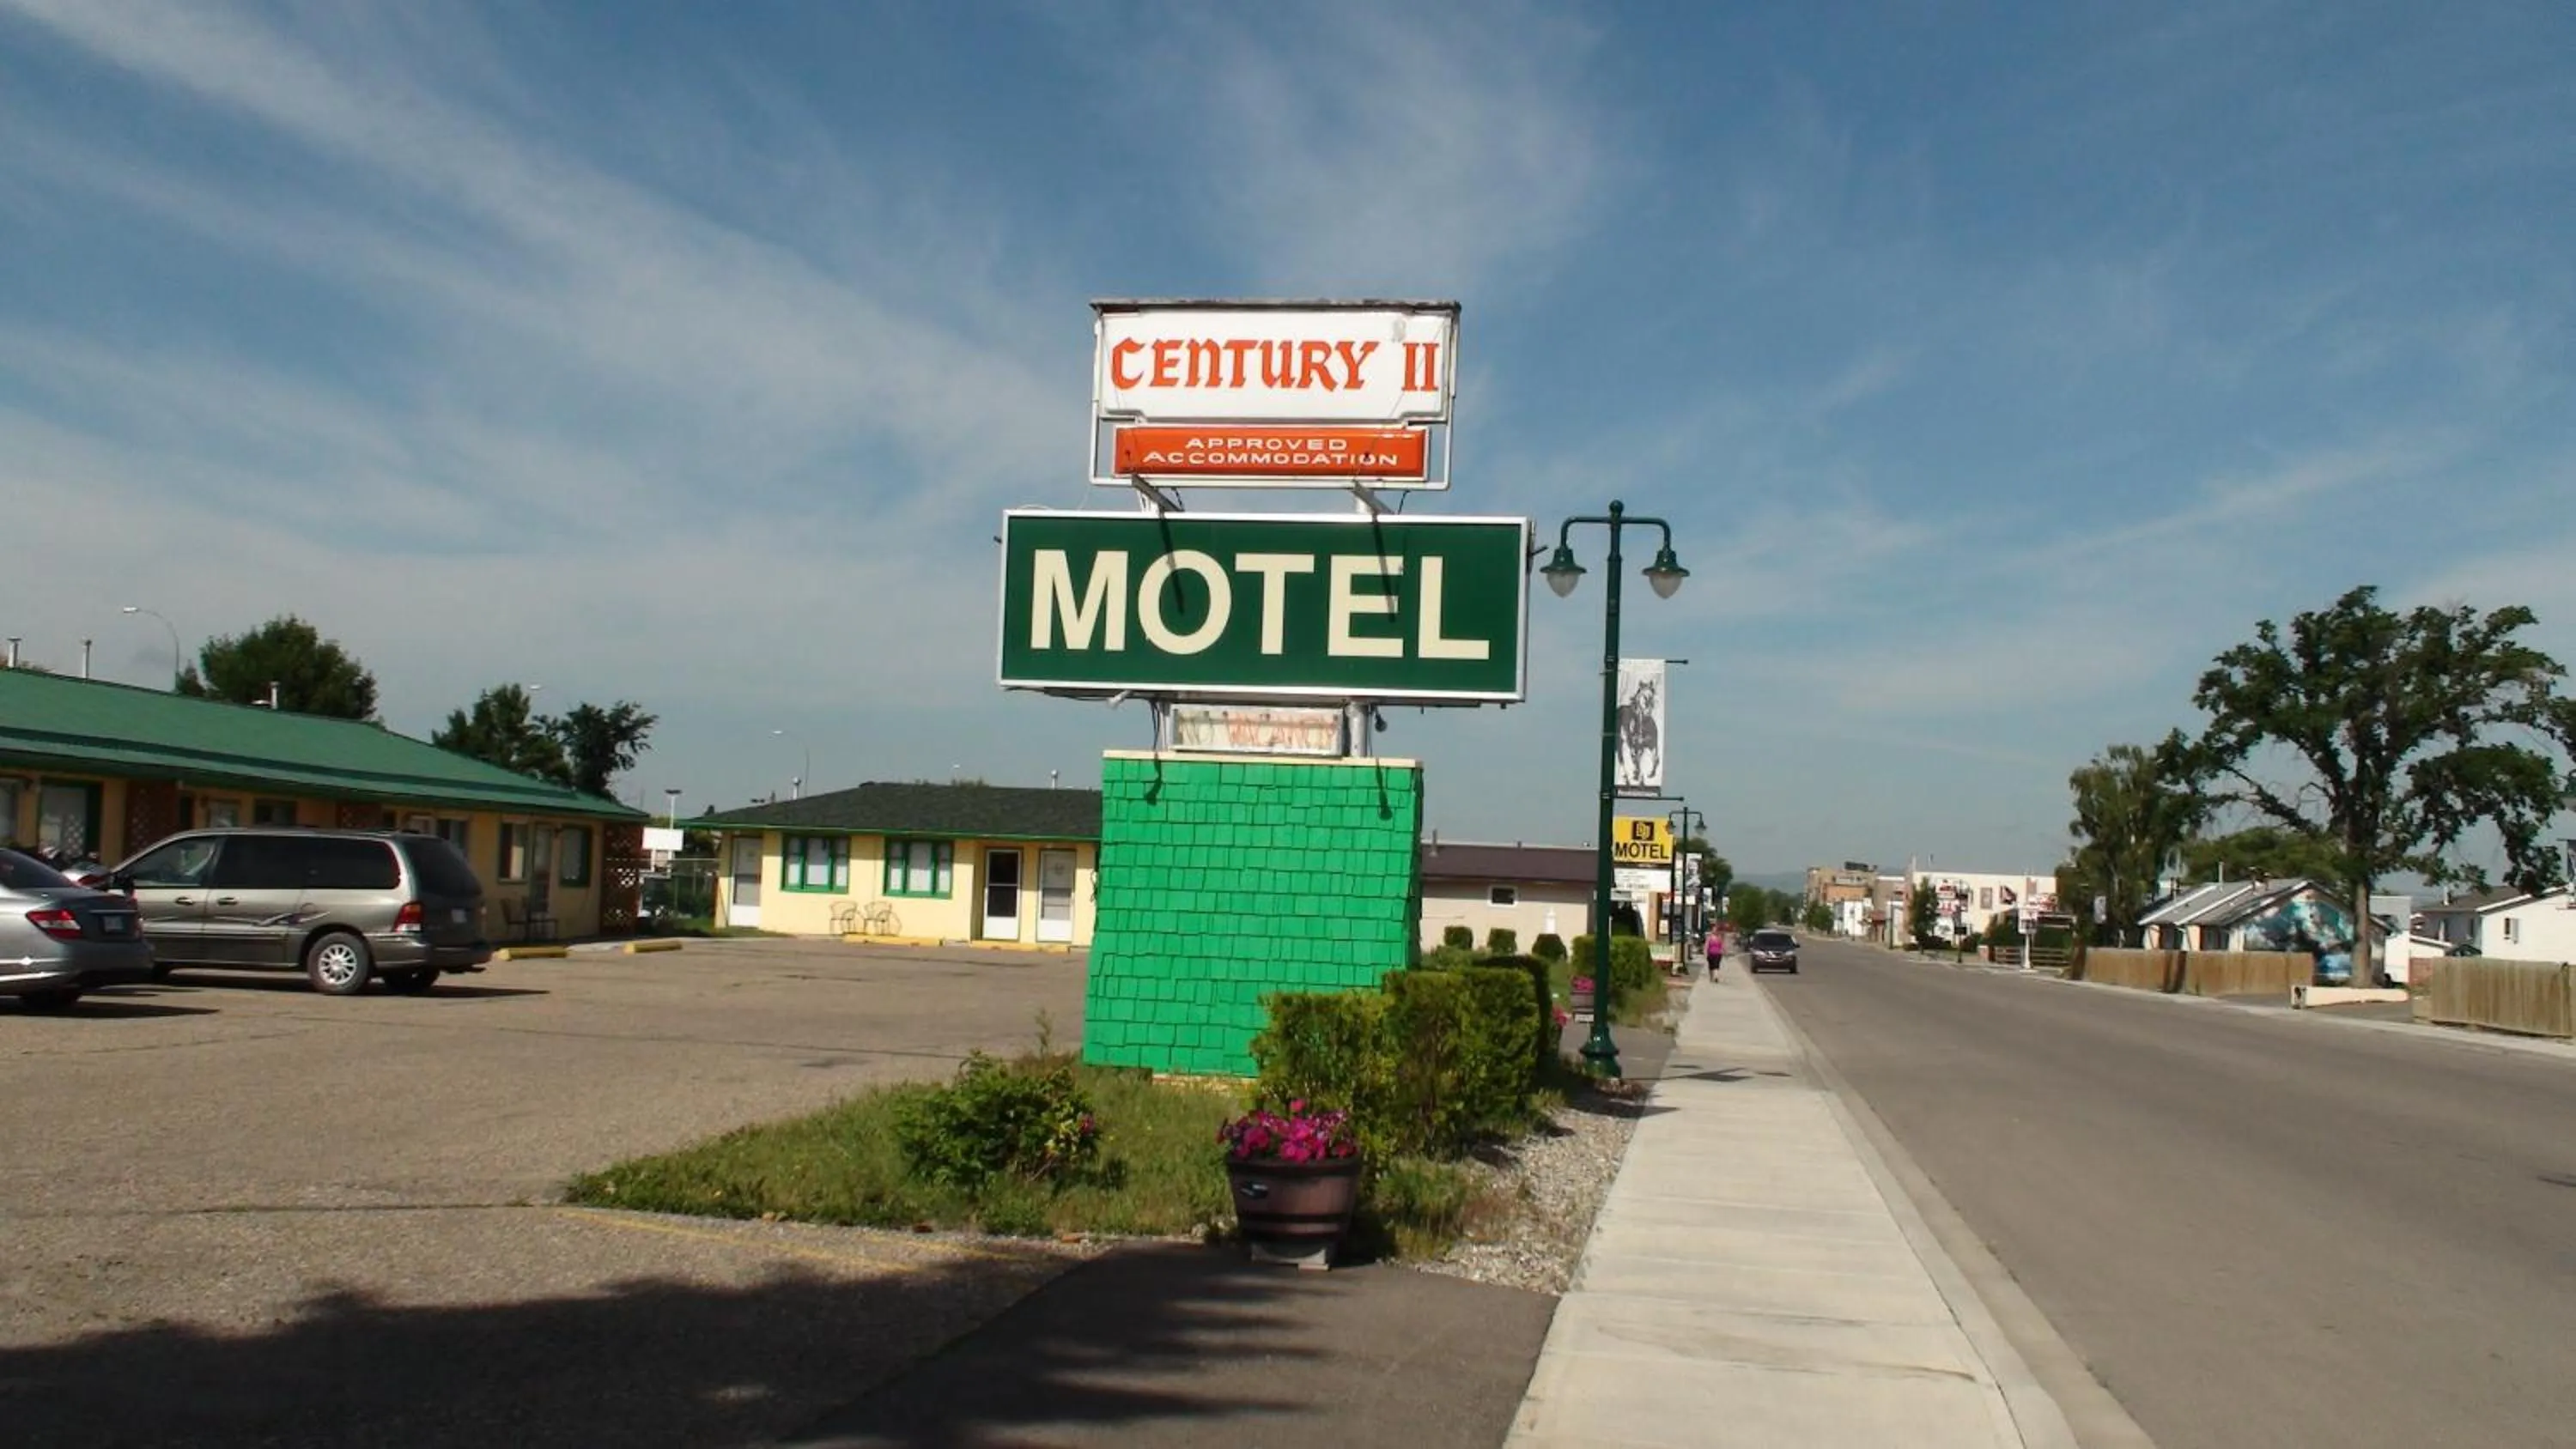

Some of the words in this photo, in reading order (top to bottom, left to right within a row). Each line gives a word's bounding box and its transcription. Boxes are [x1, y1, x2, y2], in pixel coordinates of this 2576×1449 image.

[1110, 336, 1379, 391] CENTURY
[1401, 343, 1439, 392] II
[1185, 438, 1347, 451] APPROVED
[1142, 452, 1398, 465] ACCOMMODATION
[1030, 549, 1490, 660] MOTEL
[1615, 842, 1670, 859] MOTEL
